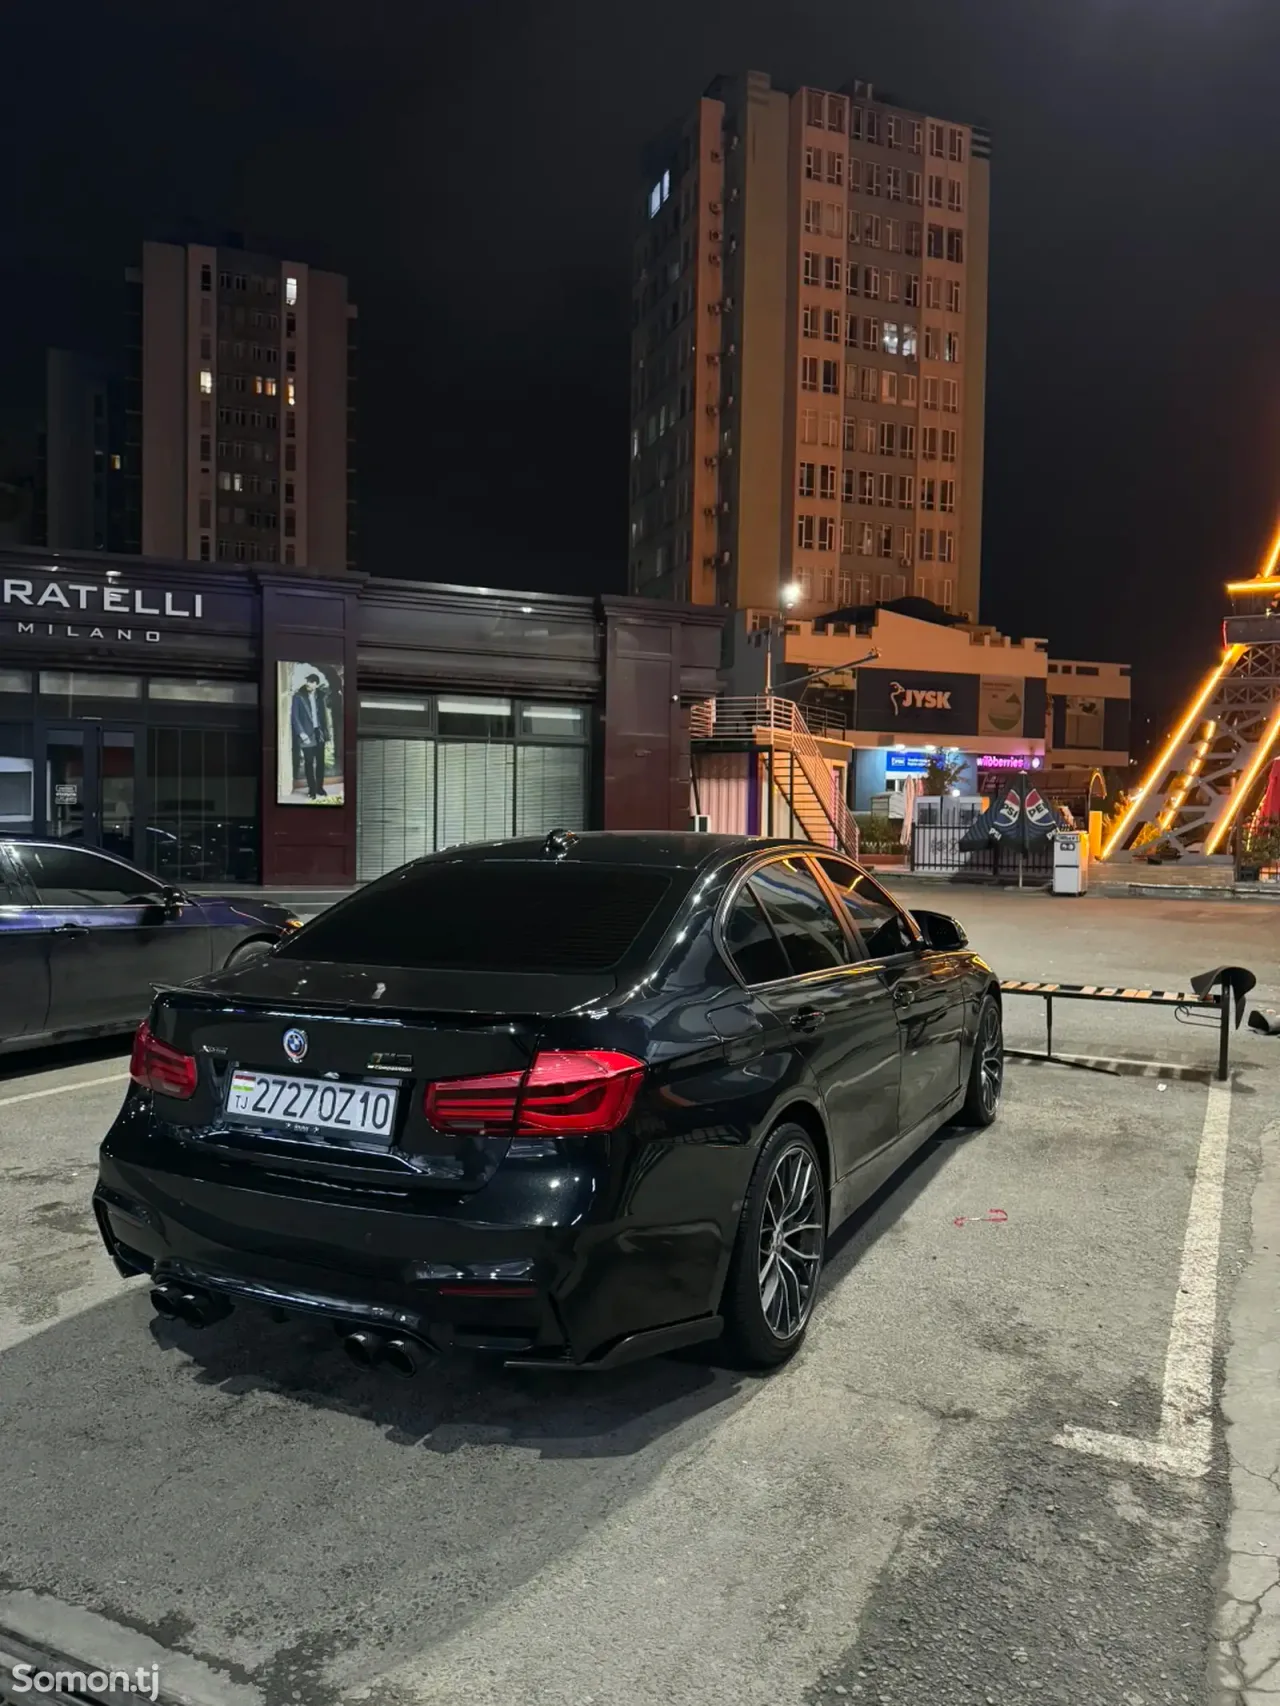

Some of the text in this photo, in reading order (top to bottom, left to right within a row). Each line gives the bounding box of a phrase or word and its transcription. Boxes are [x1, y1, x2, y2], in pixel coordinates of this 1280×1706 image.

[3, 579, 202, 617] RATELLI
[18, 622, 160, 642] MILANO
[902, 689, 951, 709] JYSK
[235, 1095, 249, 1110] TJ
